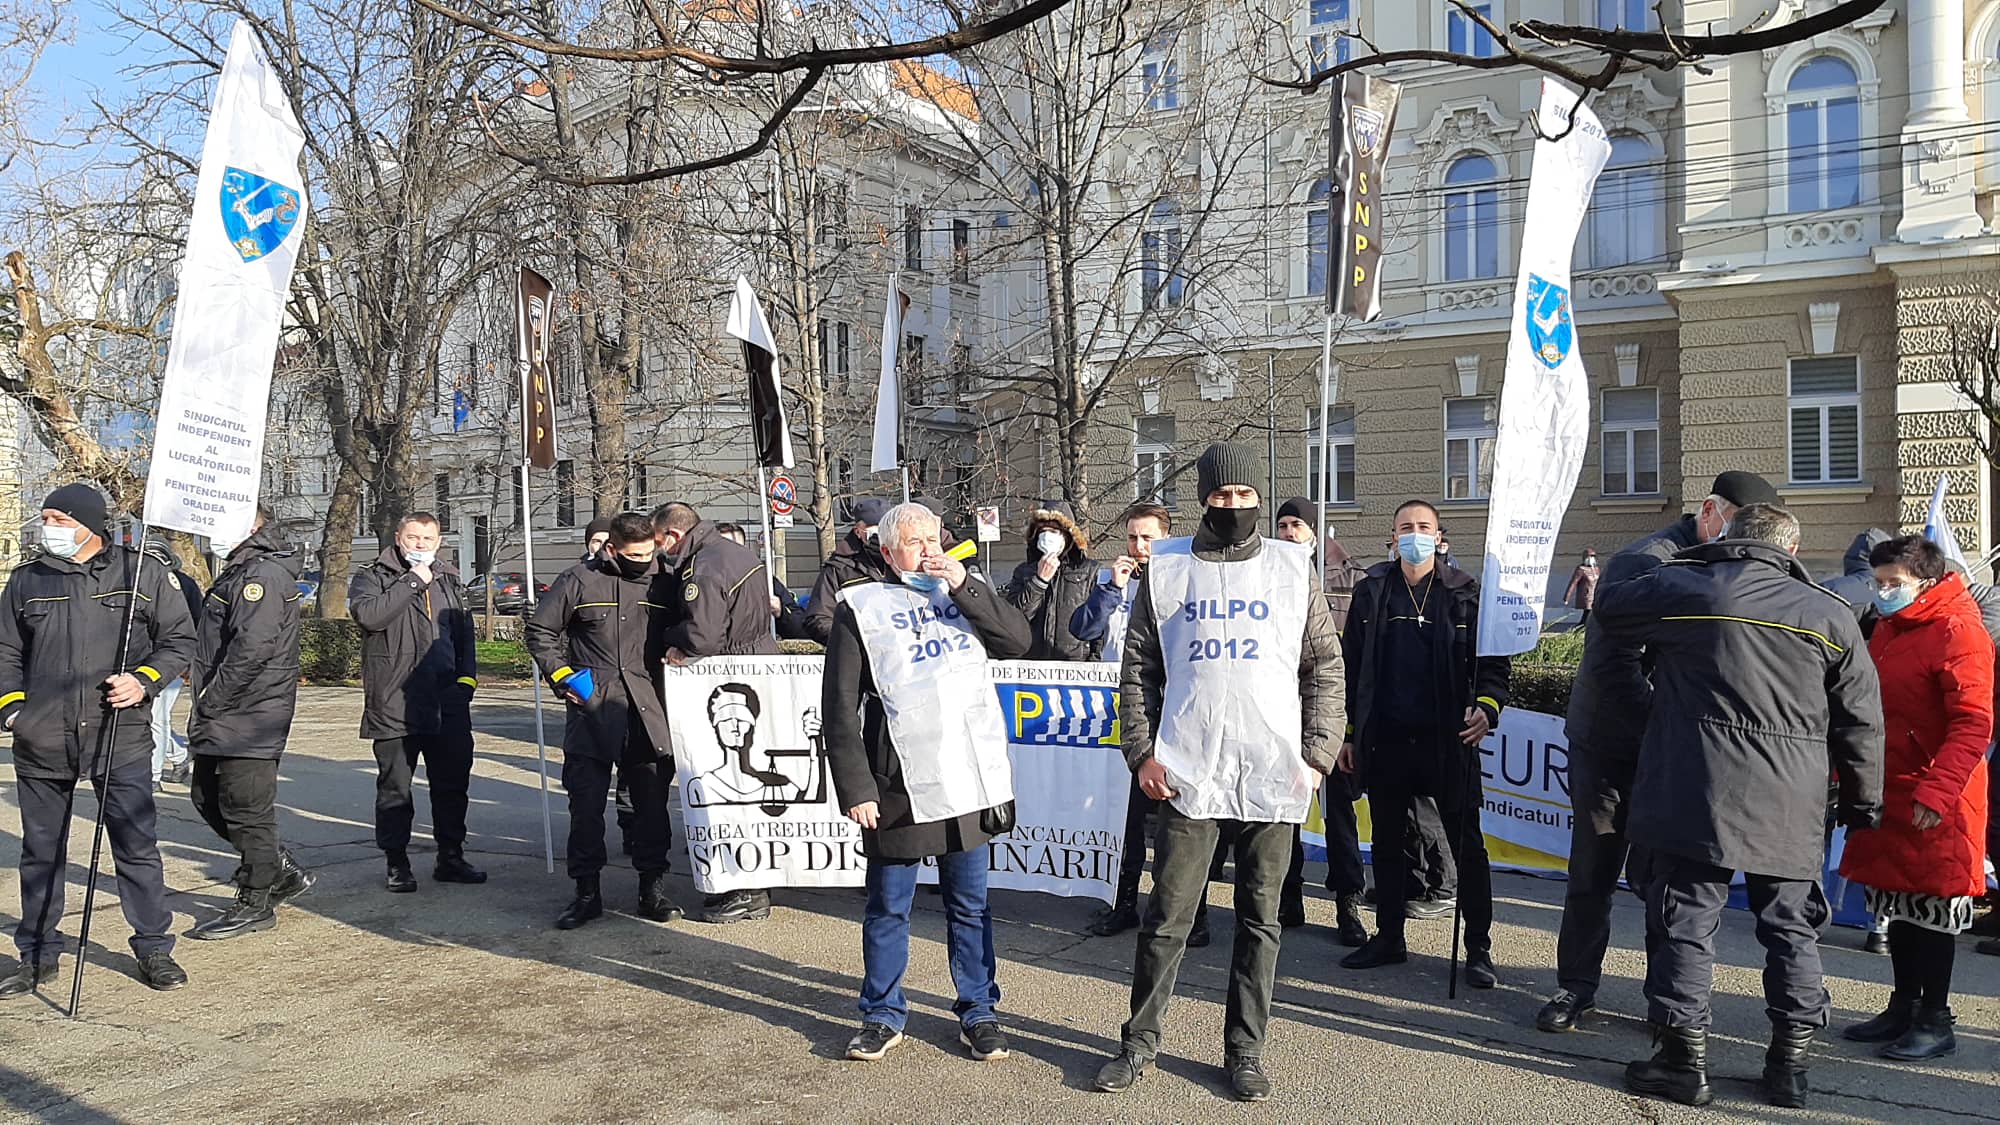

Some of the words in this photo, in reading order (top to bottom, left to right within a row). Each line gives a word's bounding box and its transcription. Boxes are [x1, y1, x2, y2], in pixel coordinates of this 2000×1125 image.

[1553, 105, 1580, 127] SILO
[184, 410, 247, 433] SINDICATUL
[178, 422, 252, 448] INDEPENDENT
[205, 445, 219, 455] AL
[197, 472, 216, 483] DIN
[165, 478, 252, 502] PENITENCIARUL
[182, 498, 226, 513] ORADEA
[190, 513, 215, 526] 2012
[1184, 599, 1269, 622] SILPO
[908, 633, 970, 664] 2012
[1188, 638, 1259, 662] 2012
[765, 663, 823, 675] NATION
[992, 667, 1012, 679] DE
[1017, 667, 1121, 683] PENITENCIAR
[686, 824, 745, 841] LEGEA
[751, 822, 849, 838] TREBUIE
[693, 841, 790, 877] STOP
